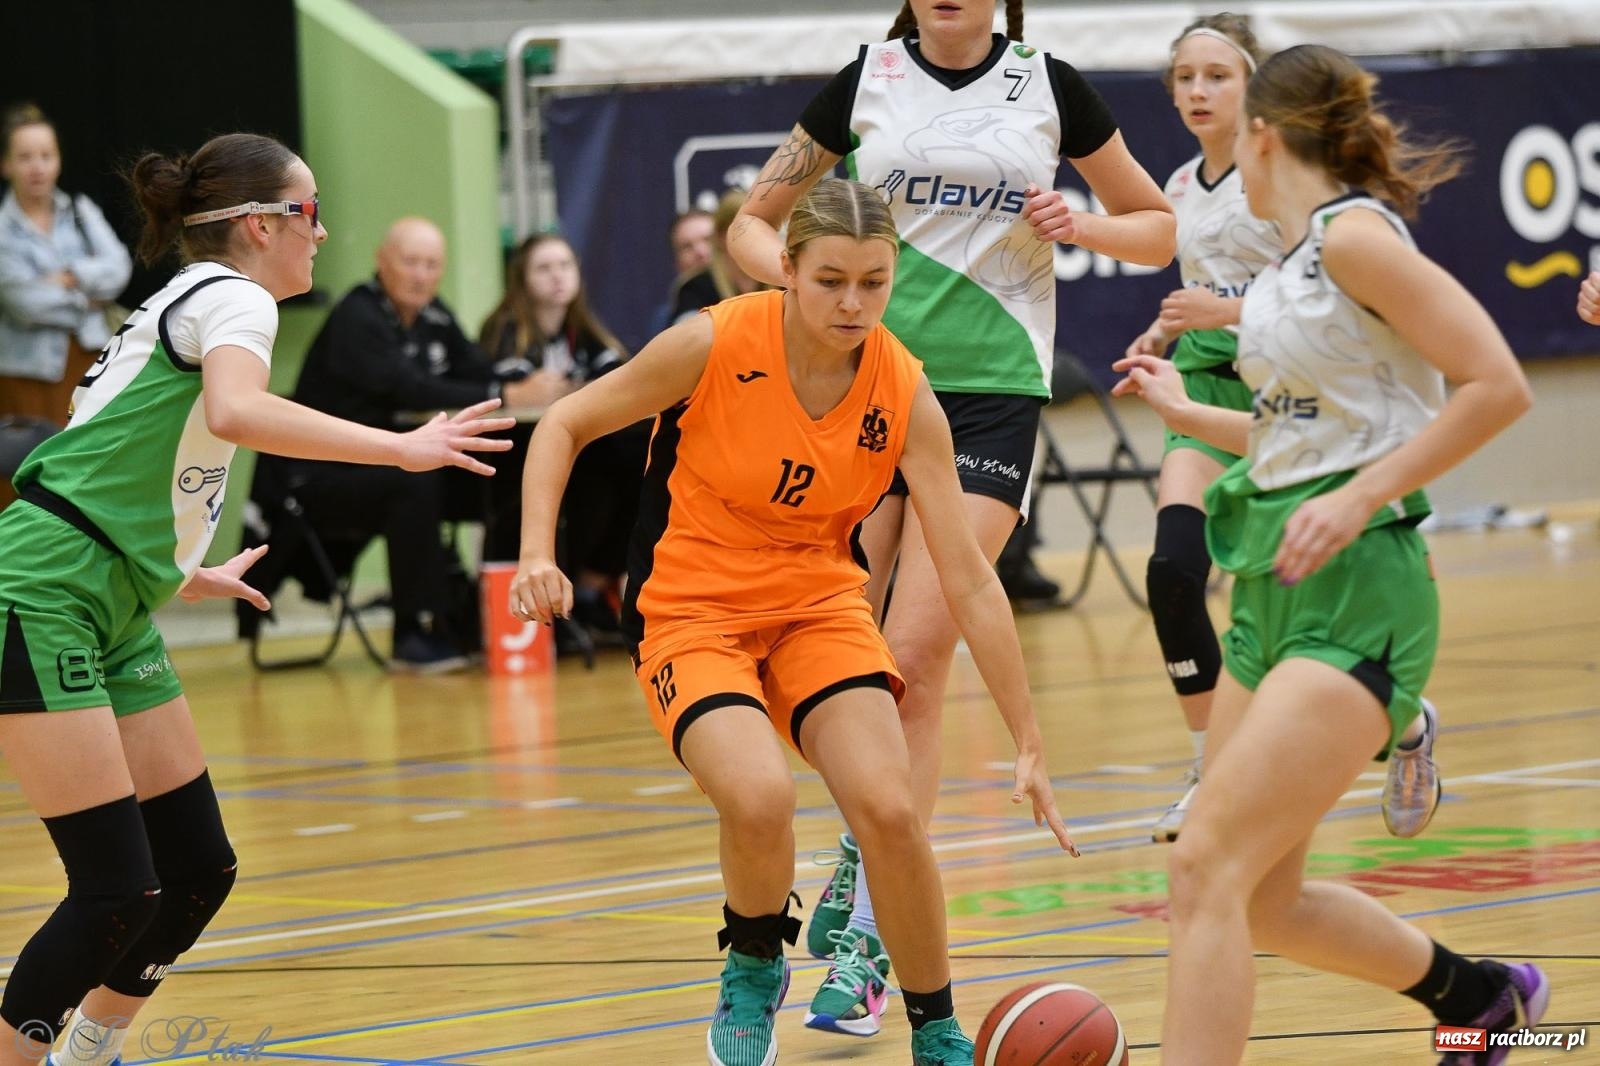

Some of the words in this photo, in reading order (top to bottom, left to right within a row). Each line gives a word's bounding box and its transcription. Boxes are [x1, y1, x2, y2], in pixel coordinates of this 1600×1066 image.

[1004, 68, 1031, 101] 7
[905, 175, 1026, 214] Clavis
[769, 458, 816, 508] 12
[650, 661, 677, 716] 12
